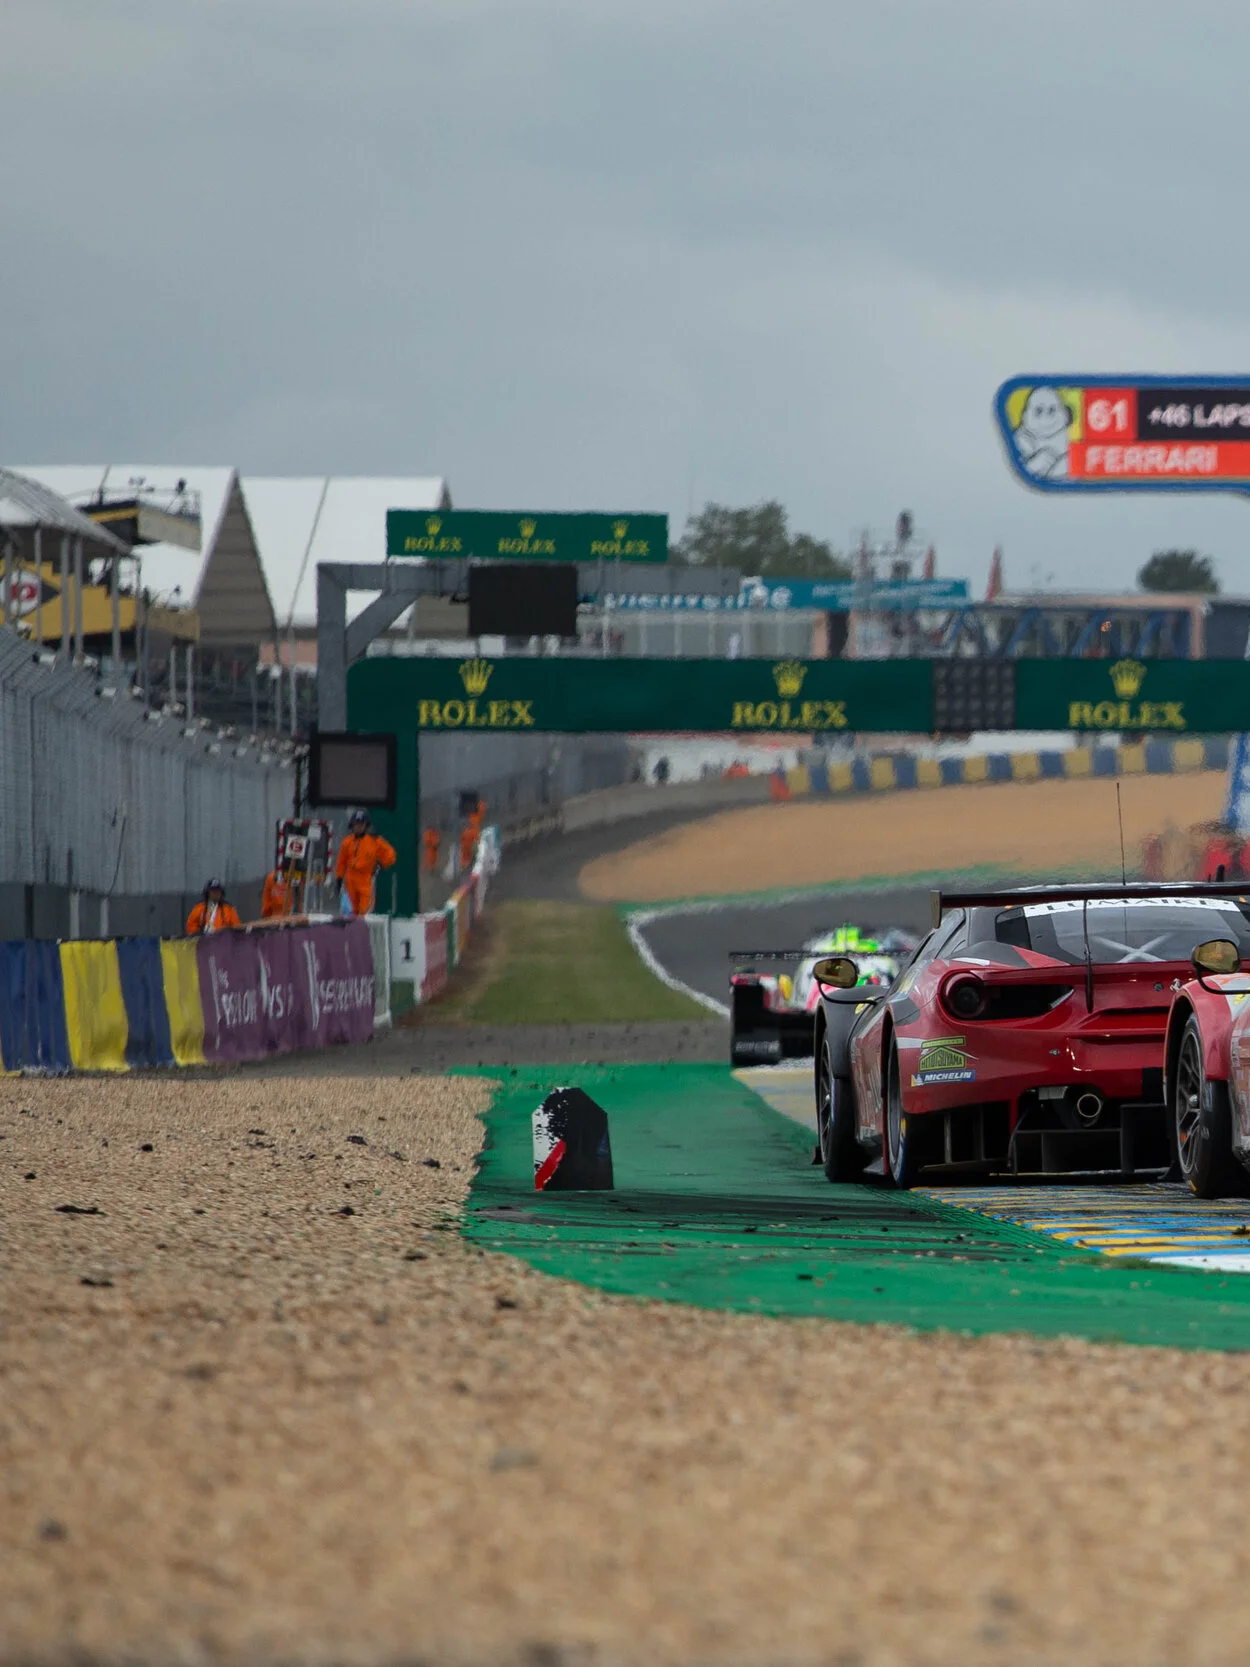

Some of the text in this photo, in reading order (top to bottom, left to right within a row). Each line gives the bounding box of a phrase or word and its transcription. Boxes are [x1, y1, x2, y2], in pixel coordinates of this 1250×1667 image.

[1087, 399, 1129, 432] 61
[1085, 445, 1219, 474] FERRARI
[404, 537, 462, 552] ROLEX
[498, 539, 556, 554] ROLEX
[590, 540, 650, 556] ROLEX
[417, 700, 535, 728] ROLEX
[730, 701, 848, 728] ROLEX
[1069, 702, 1186, 728] ROLEX
[401, 938, 413, 961] 1
[924, 1071, 973, 1081] MICHELIN
